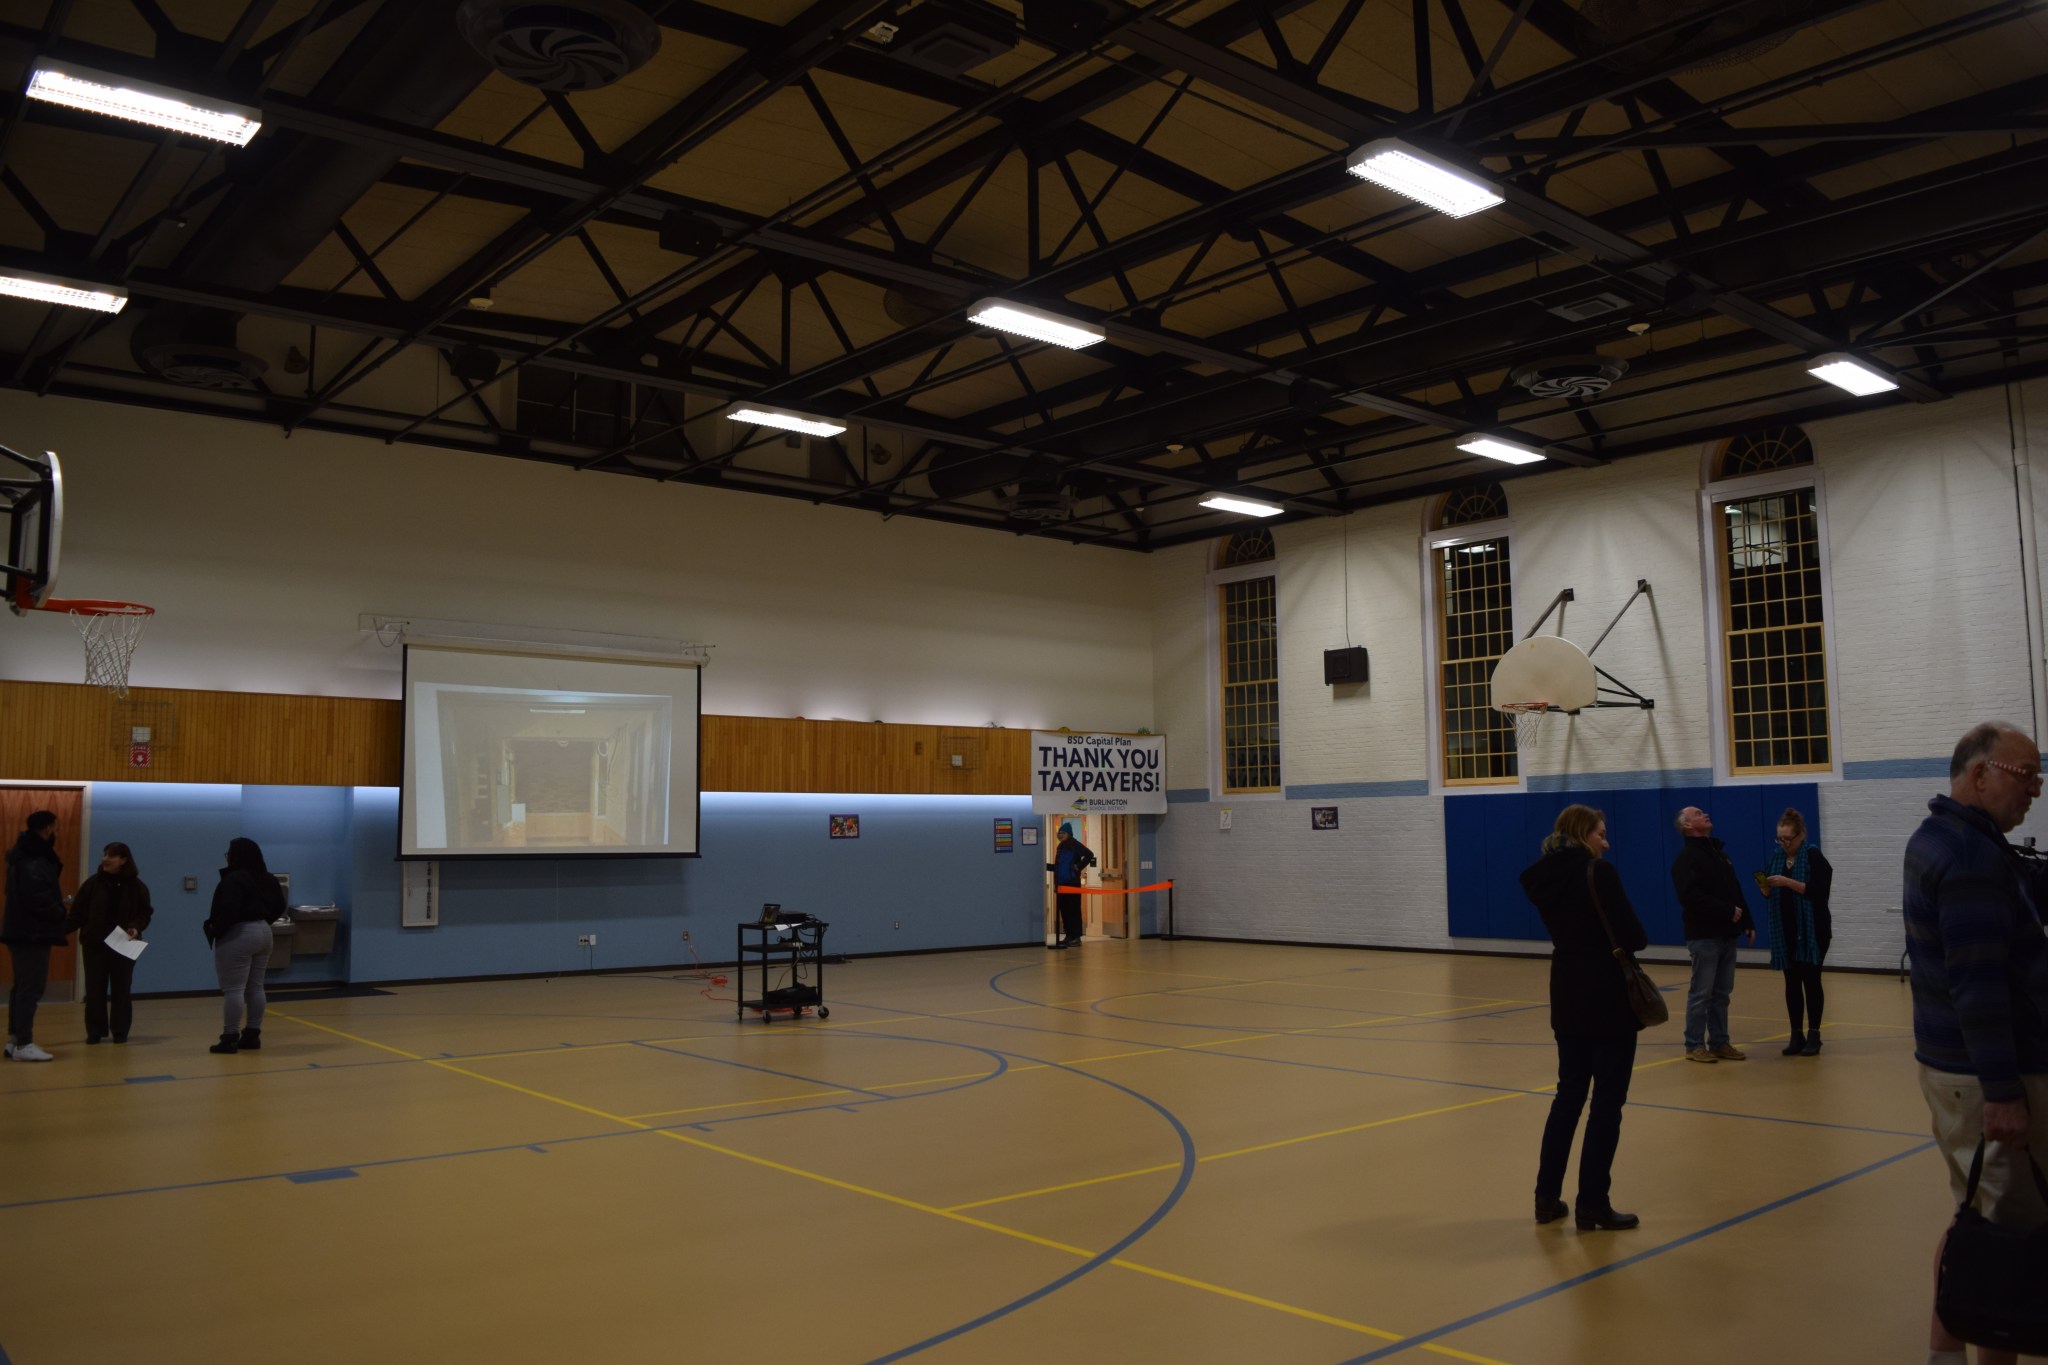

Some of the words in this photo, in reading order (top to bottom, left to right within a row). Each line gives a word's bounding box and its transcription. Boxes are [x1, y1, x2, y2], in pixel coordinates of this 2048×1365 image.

[1067, 736, 1083, 745] BSD
[1086, 736, 1113, 747] Capital
[1115, 737, 1132, 746] Plan
[1039, 746, 1114, 768] THANK
[1117, 749, 1159, 769] YOU
[1038, 771, 1160, 792] TAXPAYERS!
